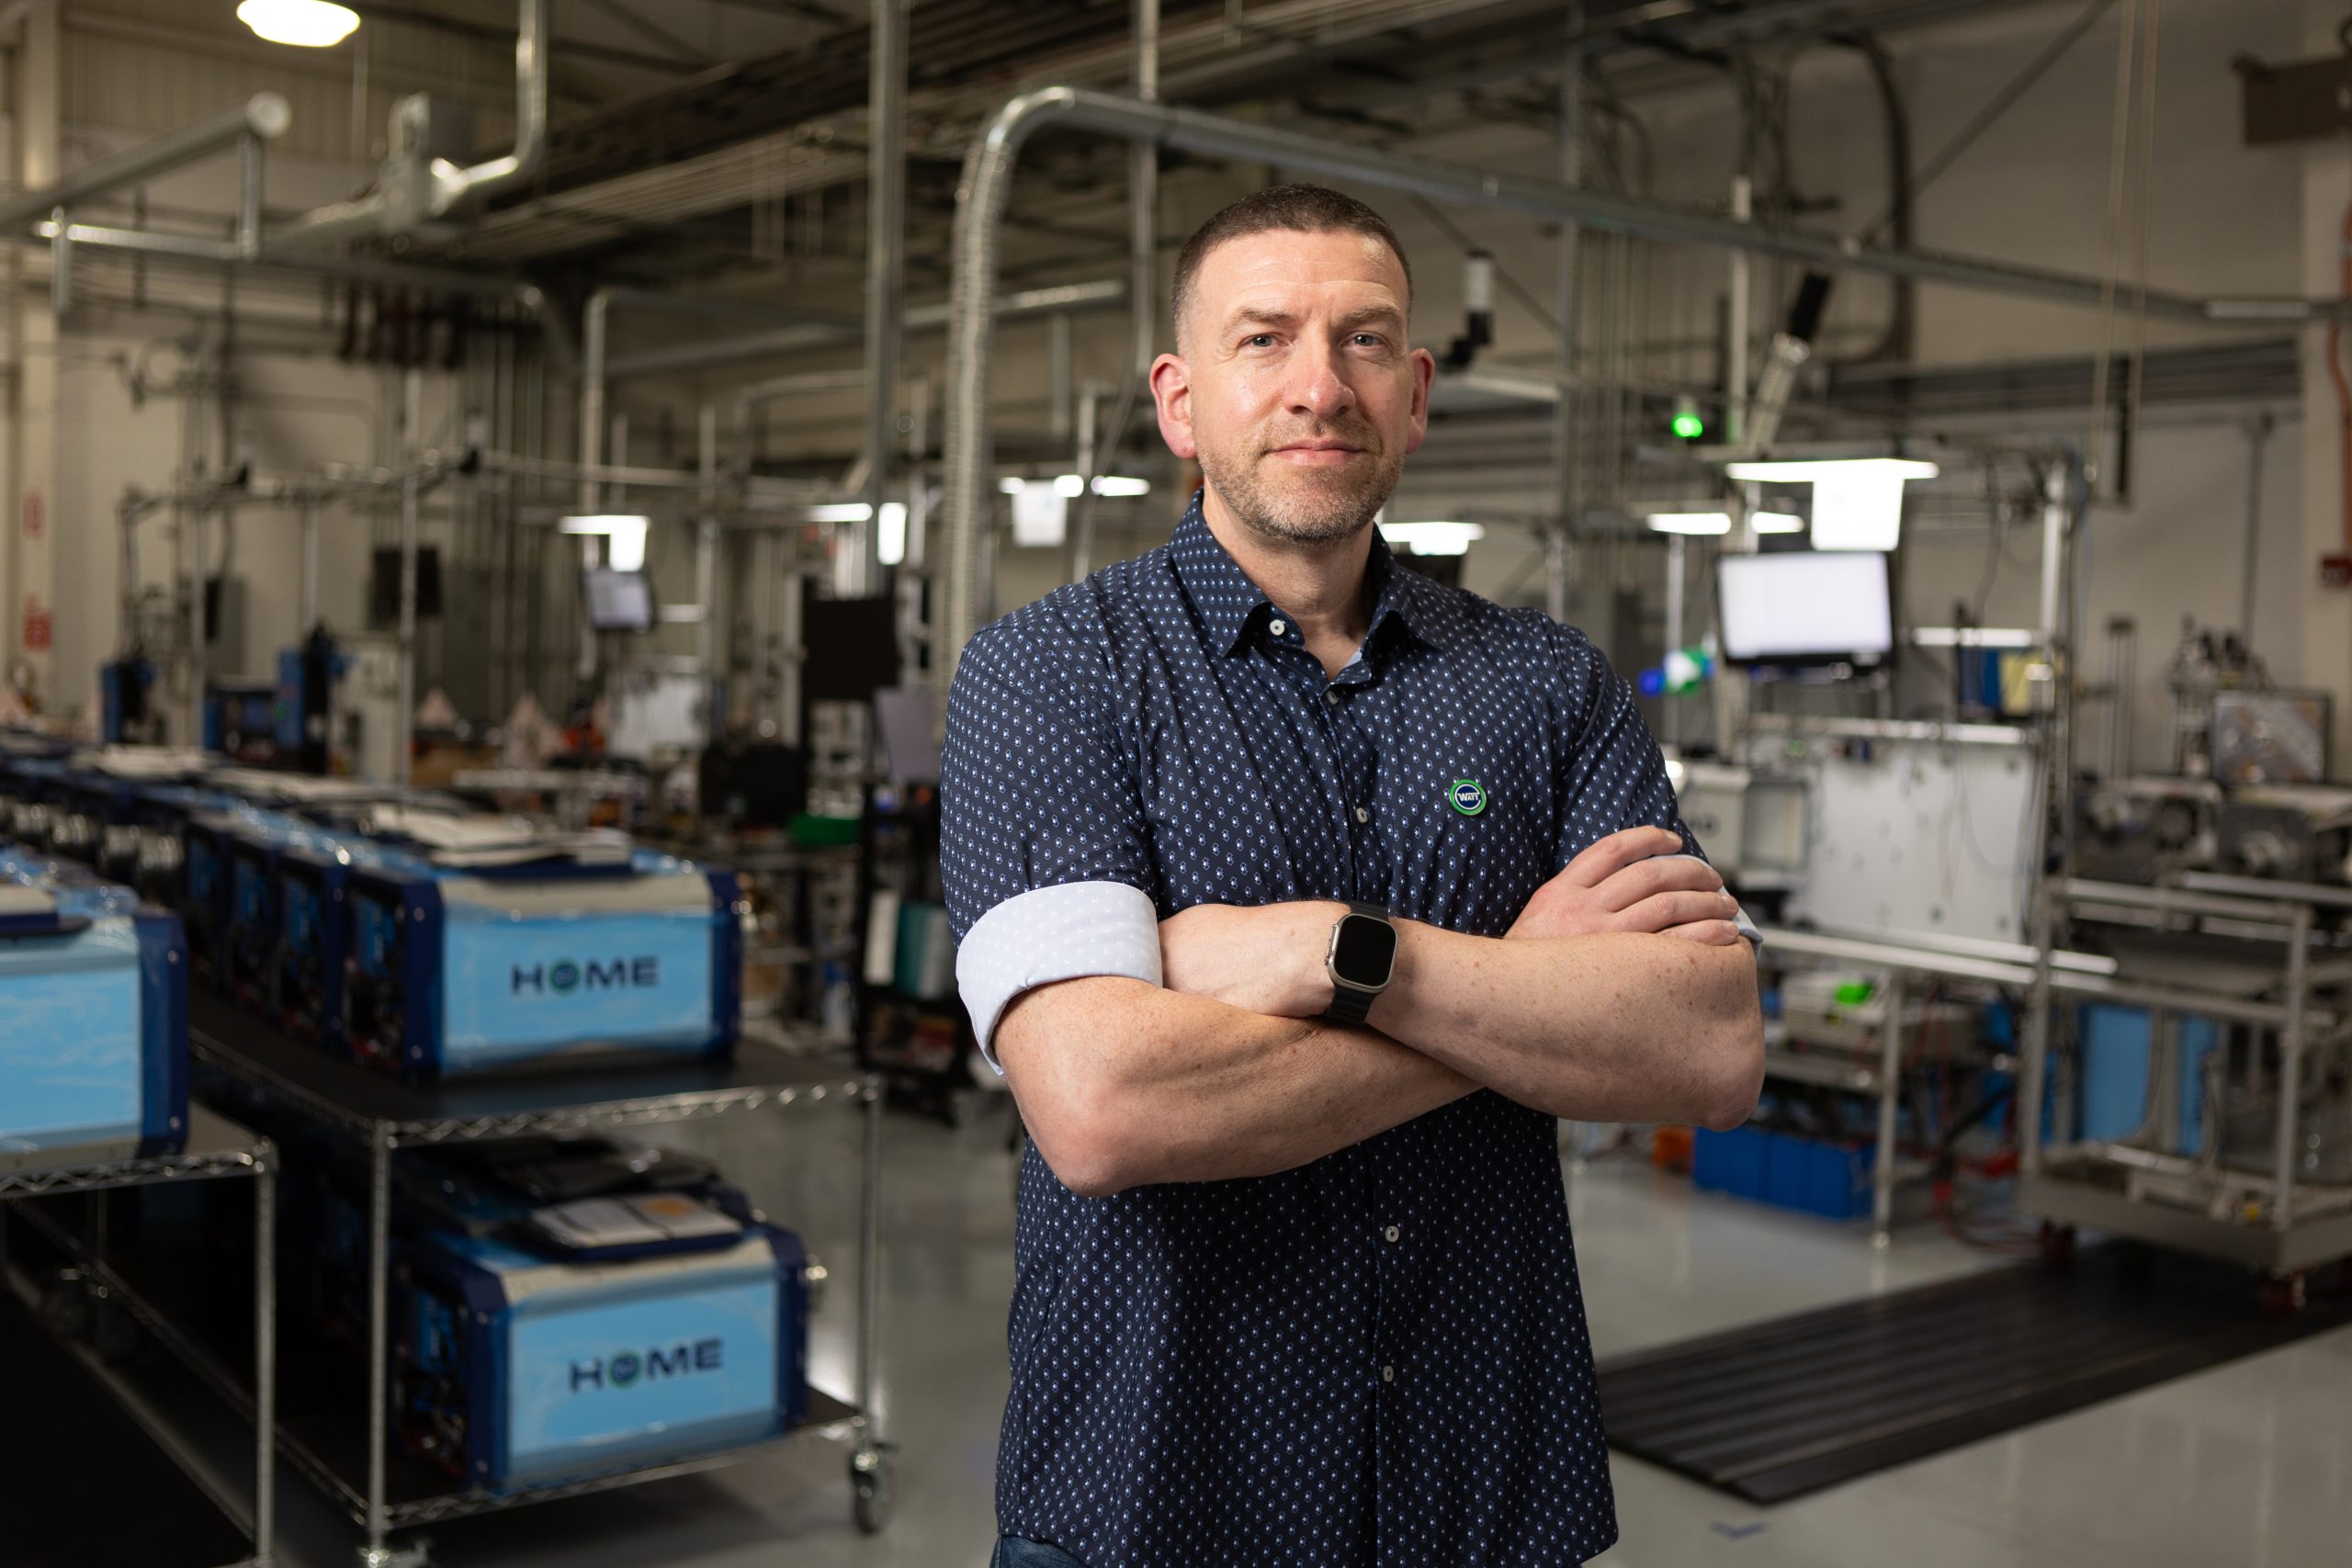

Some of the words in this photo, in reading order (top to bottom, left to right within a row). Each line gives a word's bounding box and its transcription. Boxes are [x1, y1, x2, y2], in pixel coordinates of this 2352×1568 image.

[1456, 792, 1479, 802] WATT
[511, 956, 658, 996] HOME
[569, 1337, 723, 1393] HOME
